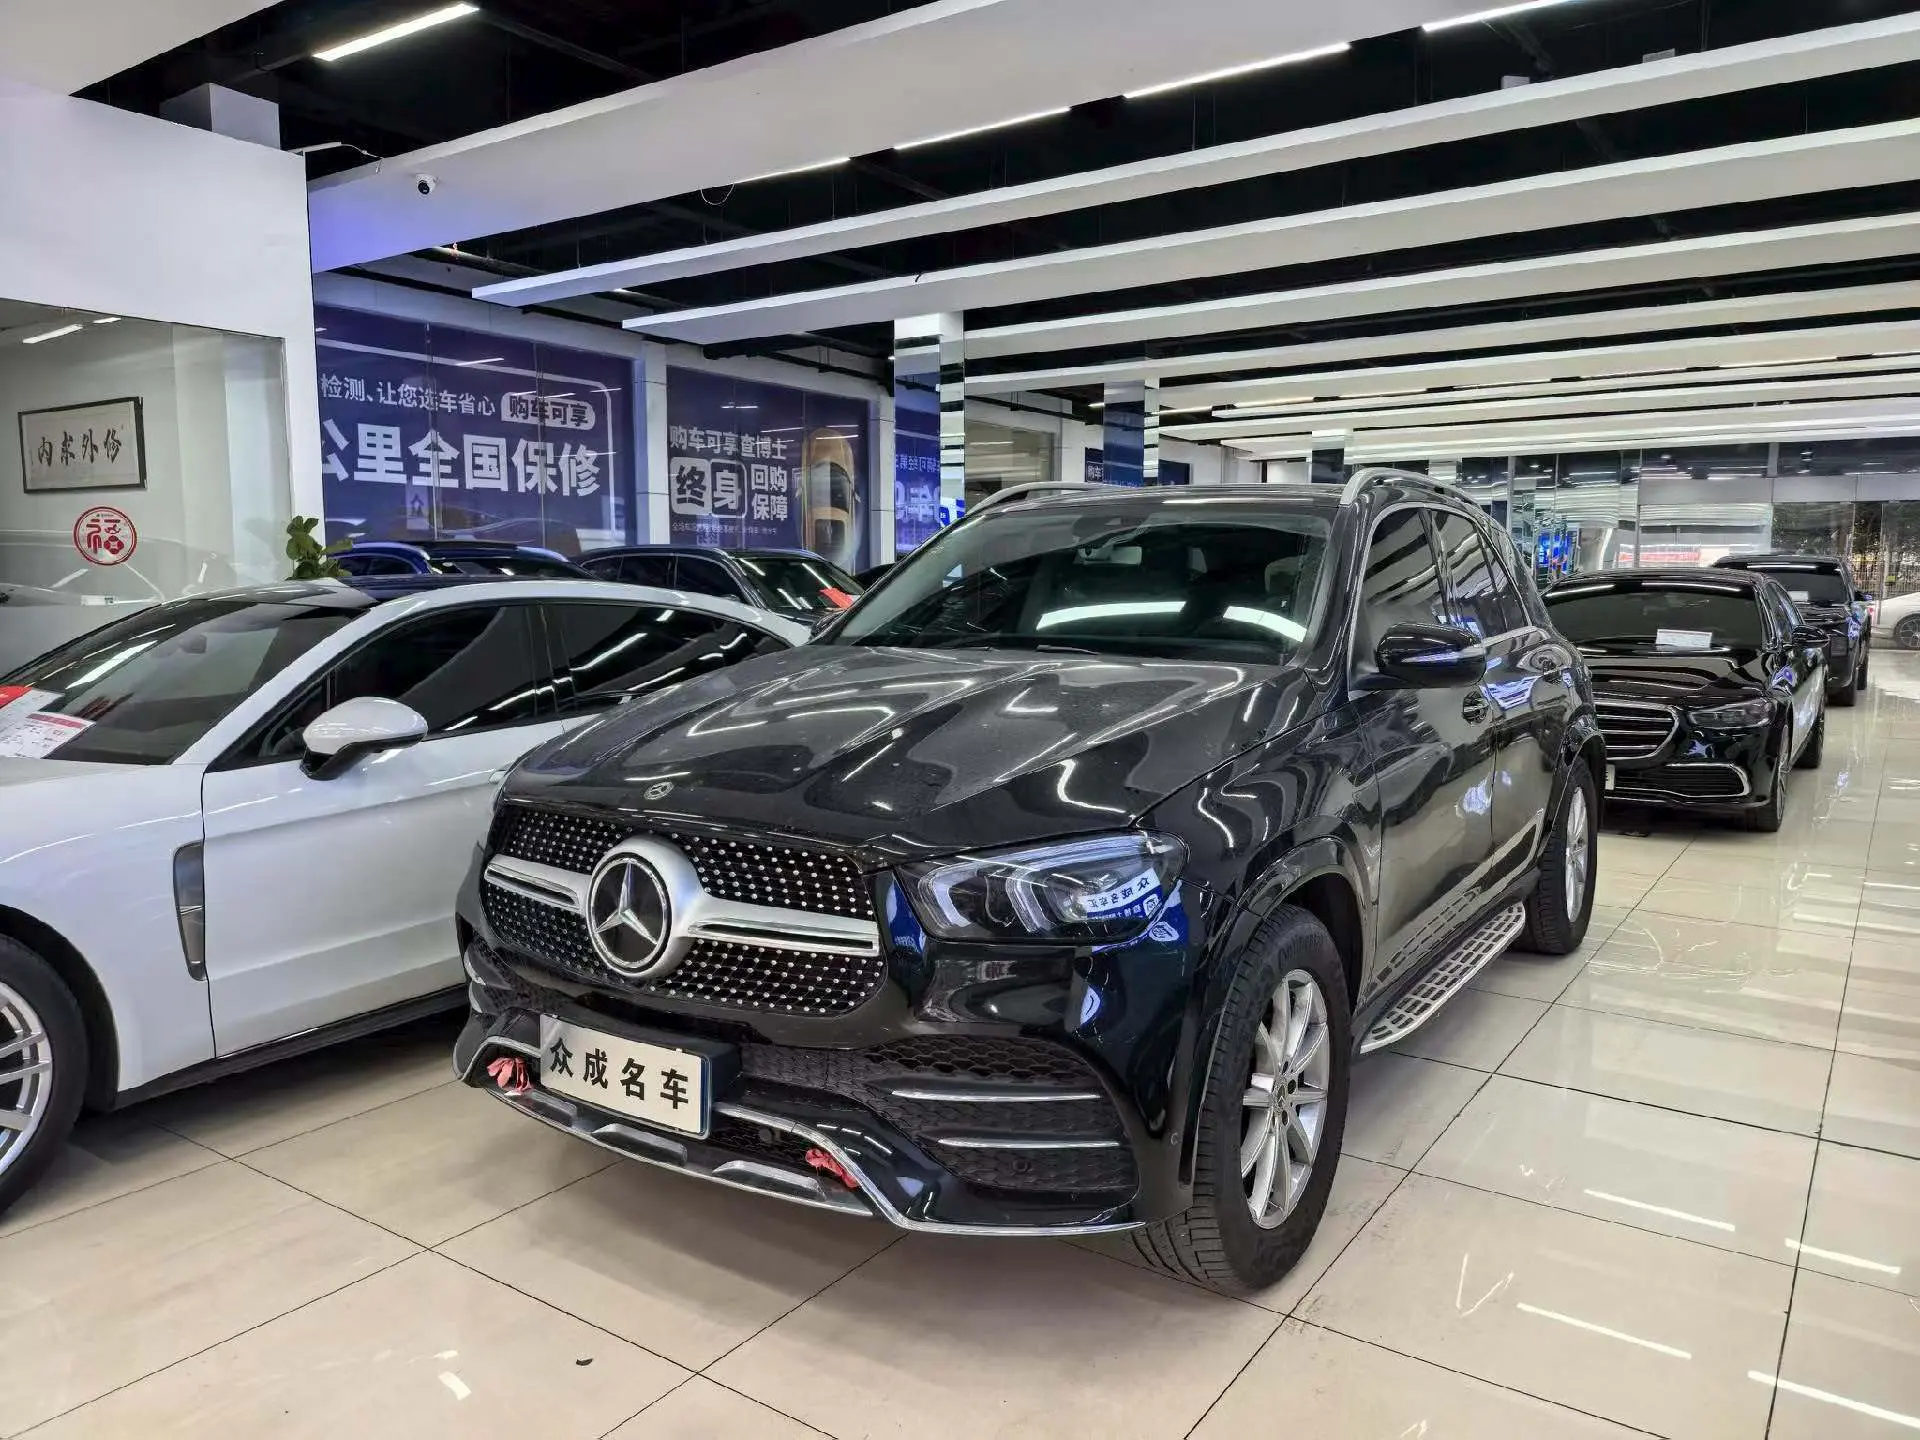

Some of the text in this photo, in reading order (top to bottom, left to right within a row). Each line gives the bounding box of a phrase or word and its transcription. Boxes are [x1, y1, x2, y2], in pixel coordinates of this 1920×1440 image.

[509, 396, 589, 427] 购车可享
[669, 425, 788, 460] 购车可享查博士
[675, 464, 742, 510] 终身
[750, 463, 788, 492] 回购
[751, 493, 788, 521] 保障
[550, 1037, 689, 1110] 众成名车
